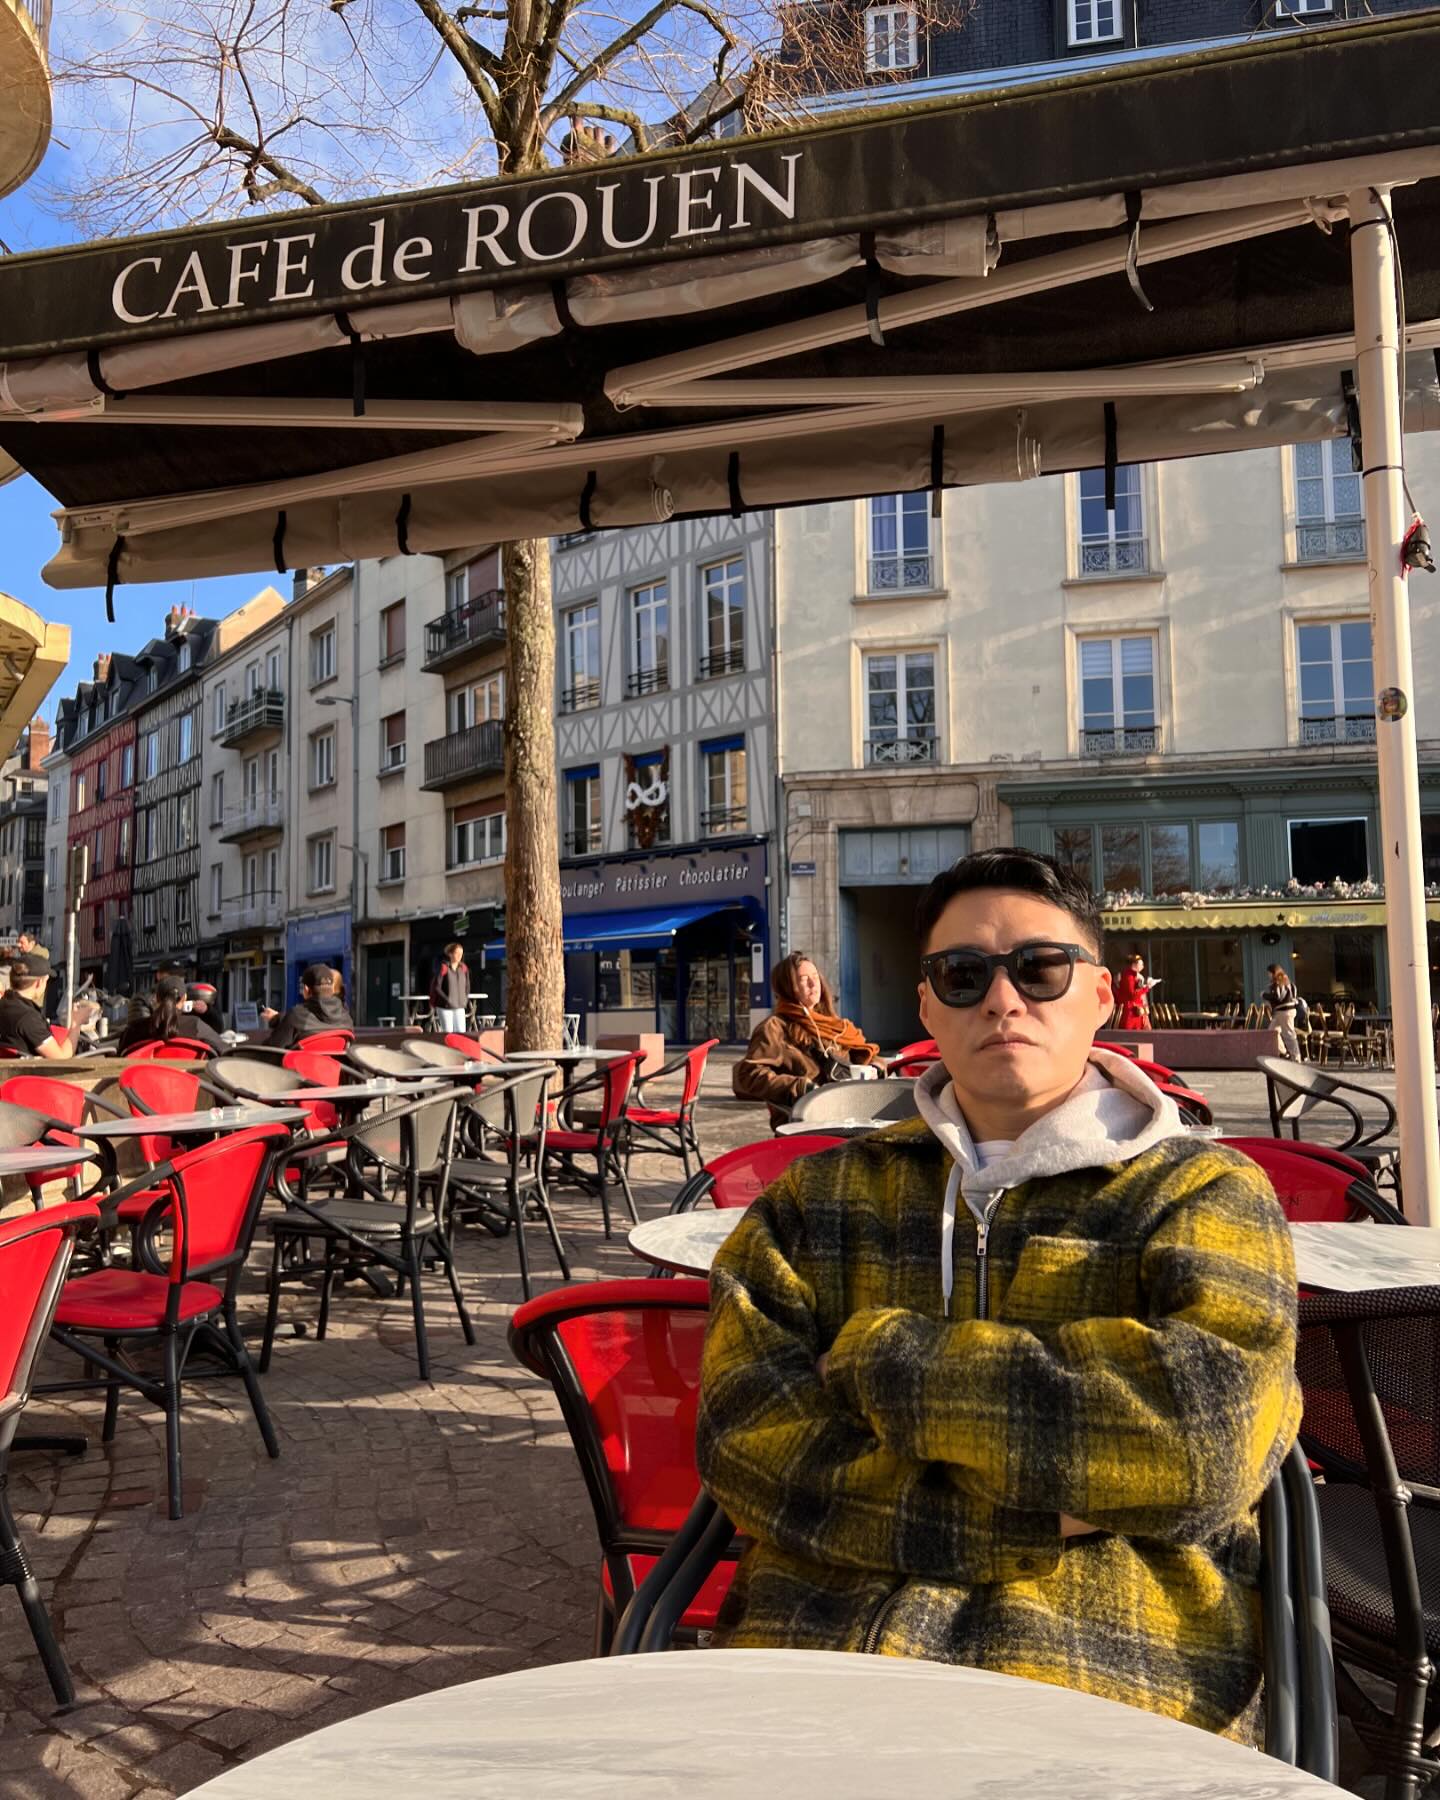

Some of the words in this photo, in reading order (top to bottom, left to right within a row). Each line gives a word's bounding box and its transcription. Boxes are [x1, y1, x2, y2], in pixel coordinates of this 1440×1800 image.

[112, 233, 316, 325] CAFE
[341, 218, 433, 291] de
[458, 153, 804, 273] ROUEN
[560, 881, 605, 898] oulanger
[679, 864, 749, 886] Chocolatier
